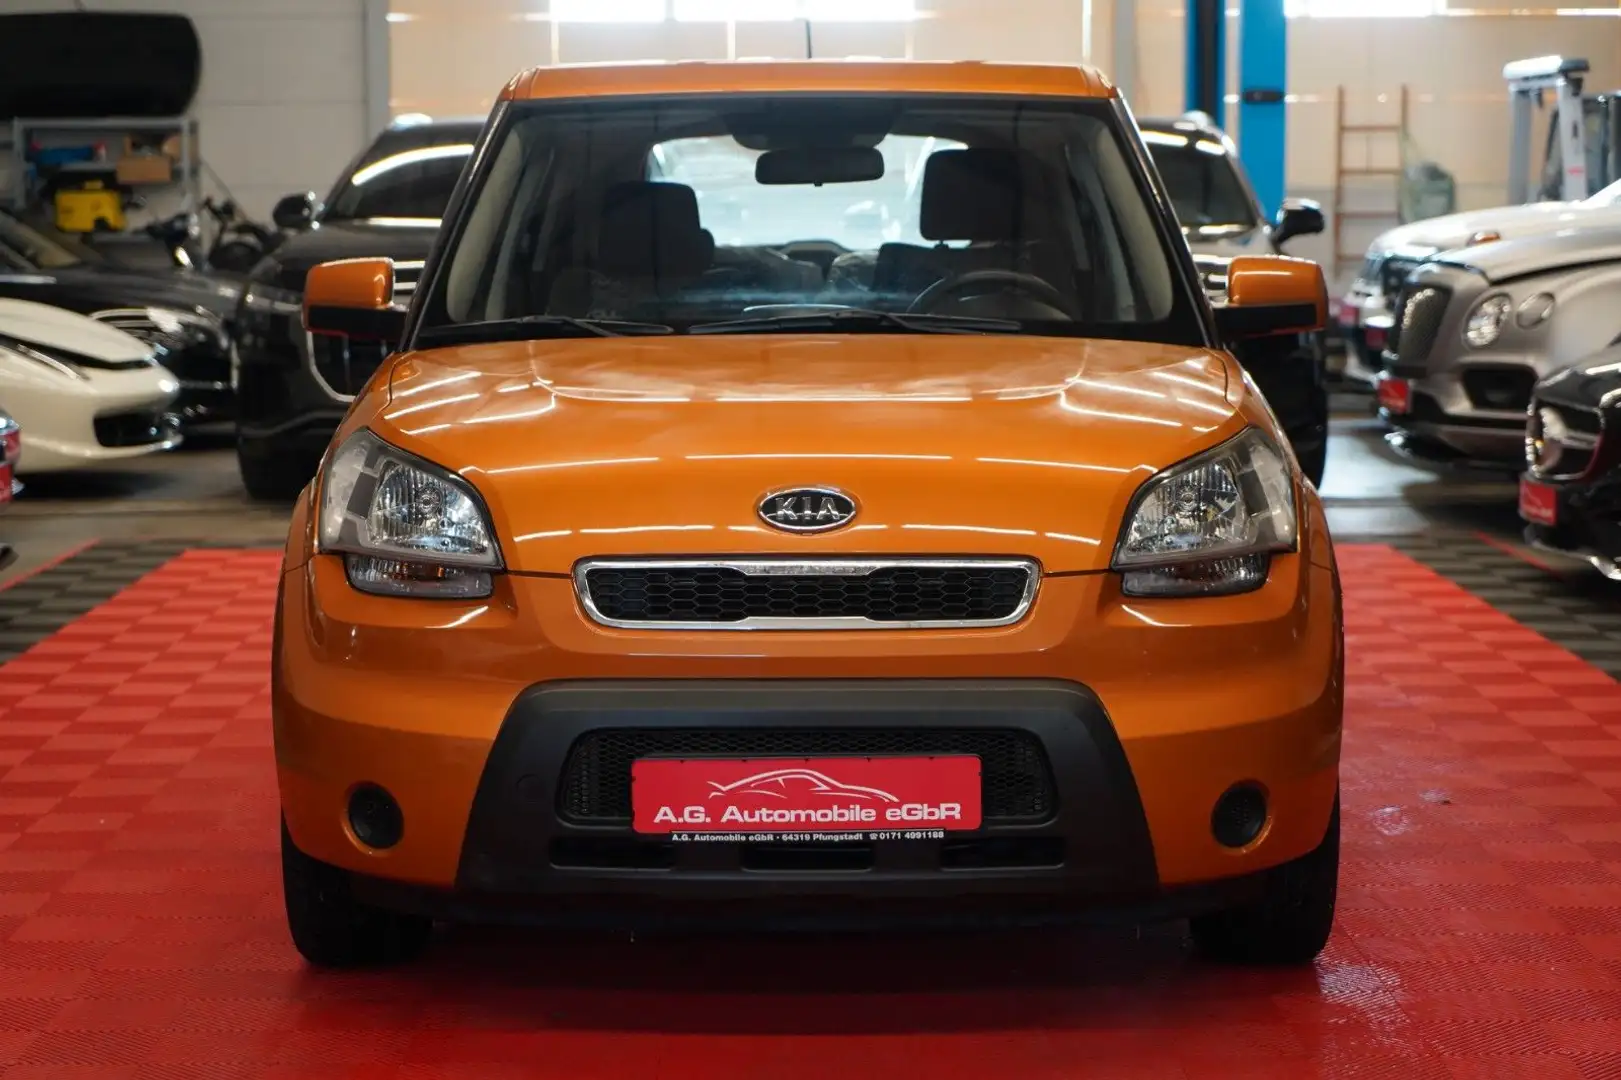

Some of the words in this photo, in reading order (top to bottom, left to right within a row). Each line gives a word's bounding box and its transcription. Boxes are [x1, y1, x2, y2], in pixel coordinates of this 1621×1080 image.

[775, 496, 840, 520] KIA
[653, 806, 711, 823] A.G.
[720, 804, 876, 823] Automobile
[885, 803, 961, 821] eGbR
[782, 833, 811, 841] 64319
[813, 833, 863, 842] Pfungstadt
